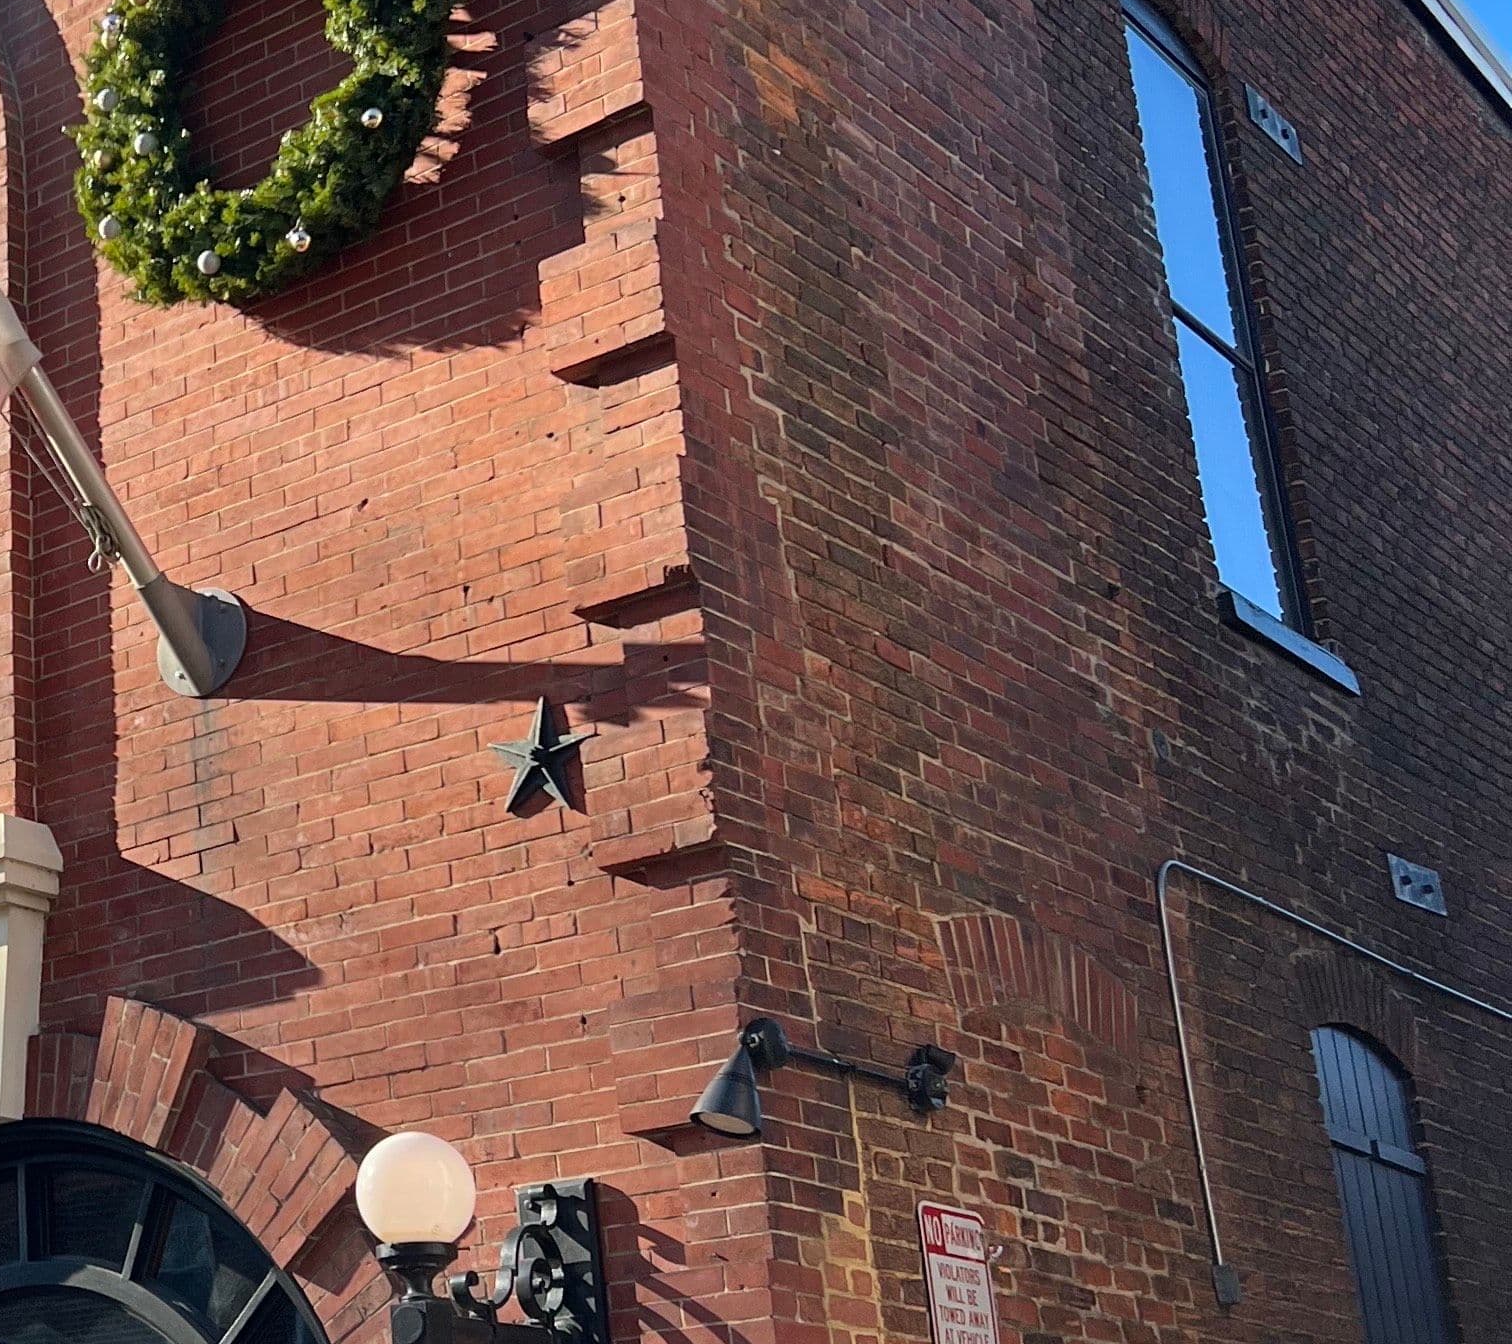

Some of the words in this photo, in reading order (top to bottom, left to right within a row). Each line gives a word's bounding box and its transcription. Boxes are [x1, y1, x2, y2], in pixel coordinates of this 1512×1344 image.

[924, 1214, 943, 1247] NO
[937, 1261, 981, 1286] VIOLATORS
[945, 1284, 966, 1305] WILL
[966, 1288, 979, 1307] BE
[938, 1304, 966, 1326] TOWED
[968, 1310, 989, 1330] AWAY
[945, 1327, 954, 1344] AT
